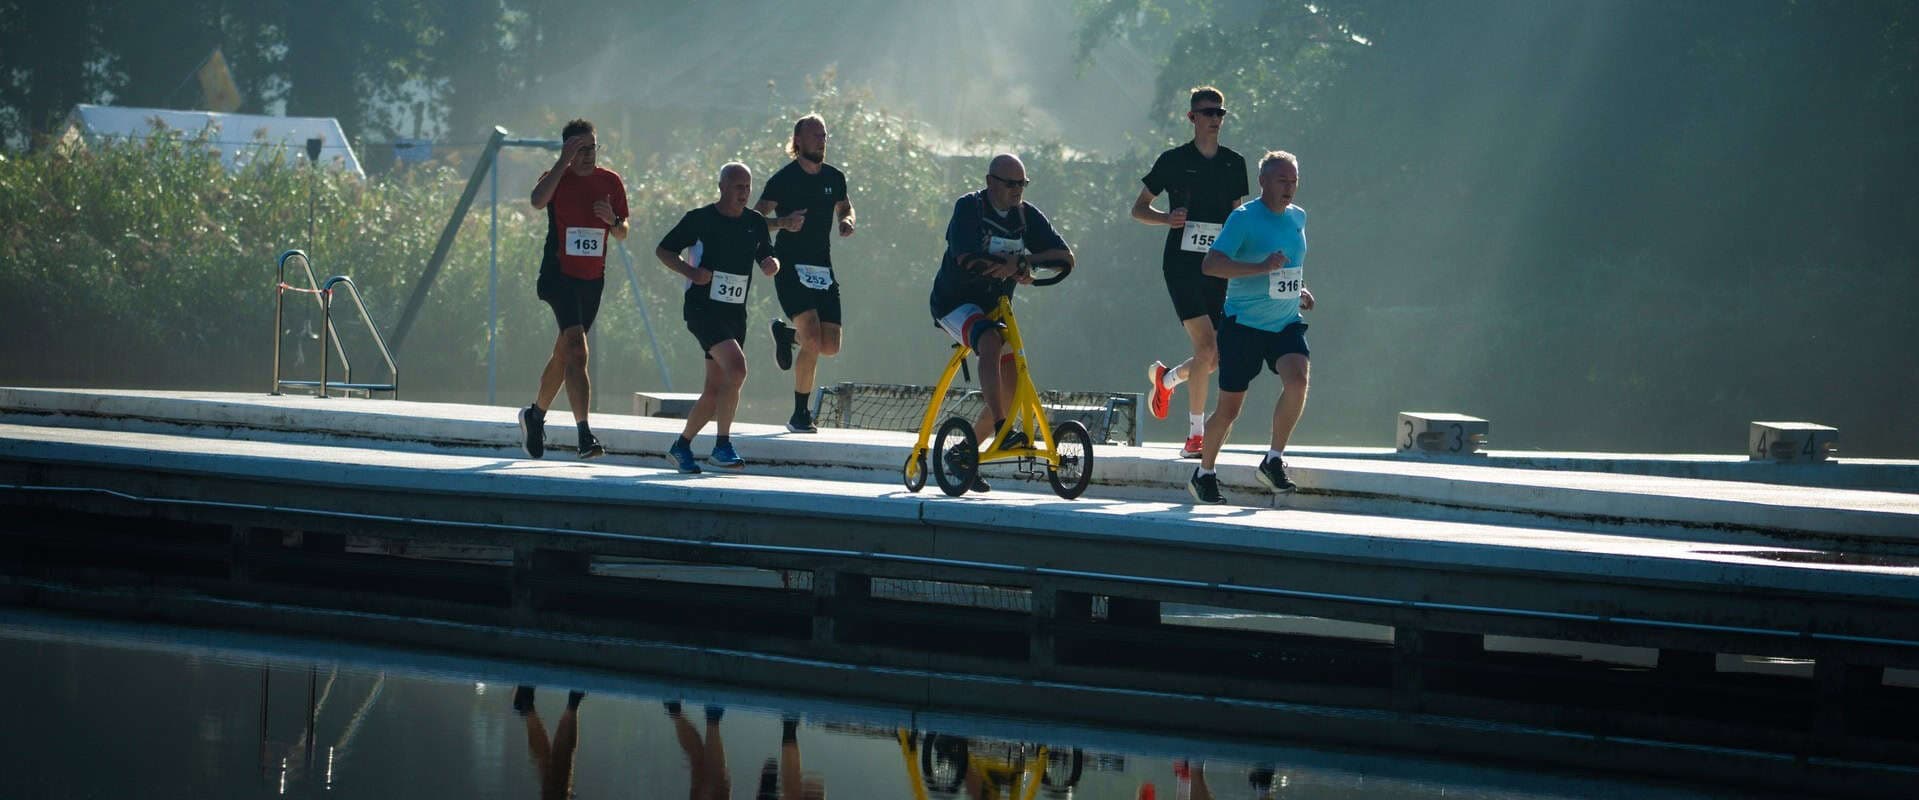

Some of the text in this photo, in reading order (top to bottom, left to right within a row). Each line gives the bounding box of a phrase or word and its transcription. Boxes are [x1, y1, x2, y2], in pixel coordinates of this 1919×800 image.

[574, 239, 598, 250] 163
[1191, 234, 1215, 246] 155
[718, 284, 743, 297] 310
[1278, 280, 1299, 292] 316
[1403, 420, 1414, 449] 3
[1449, 423, 1464, 452] 3
[1757, 431, 1768, 459] 4
[1801, 432, 1816, 459] 4
